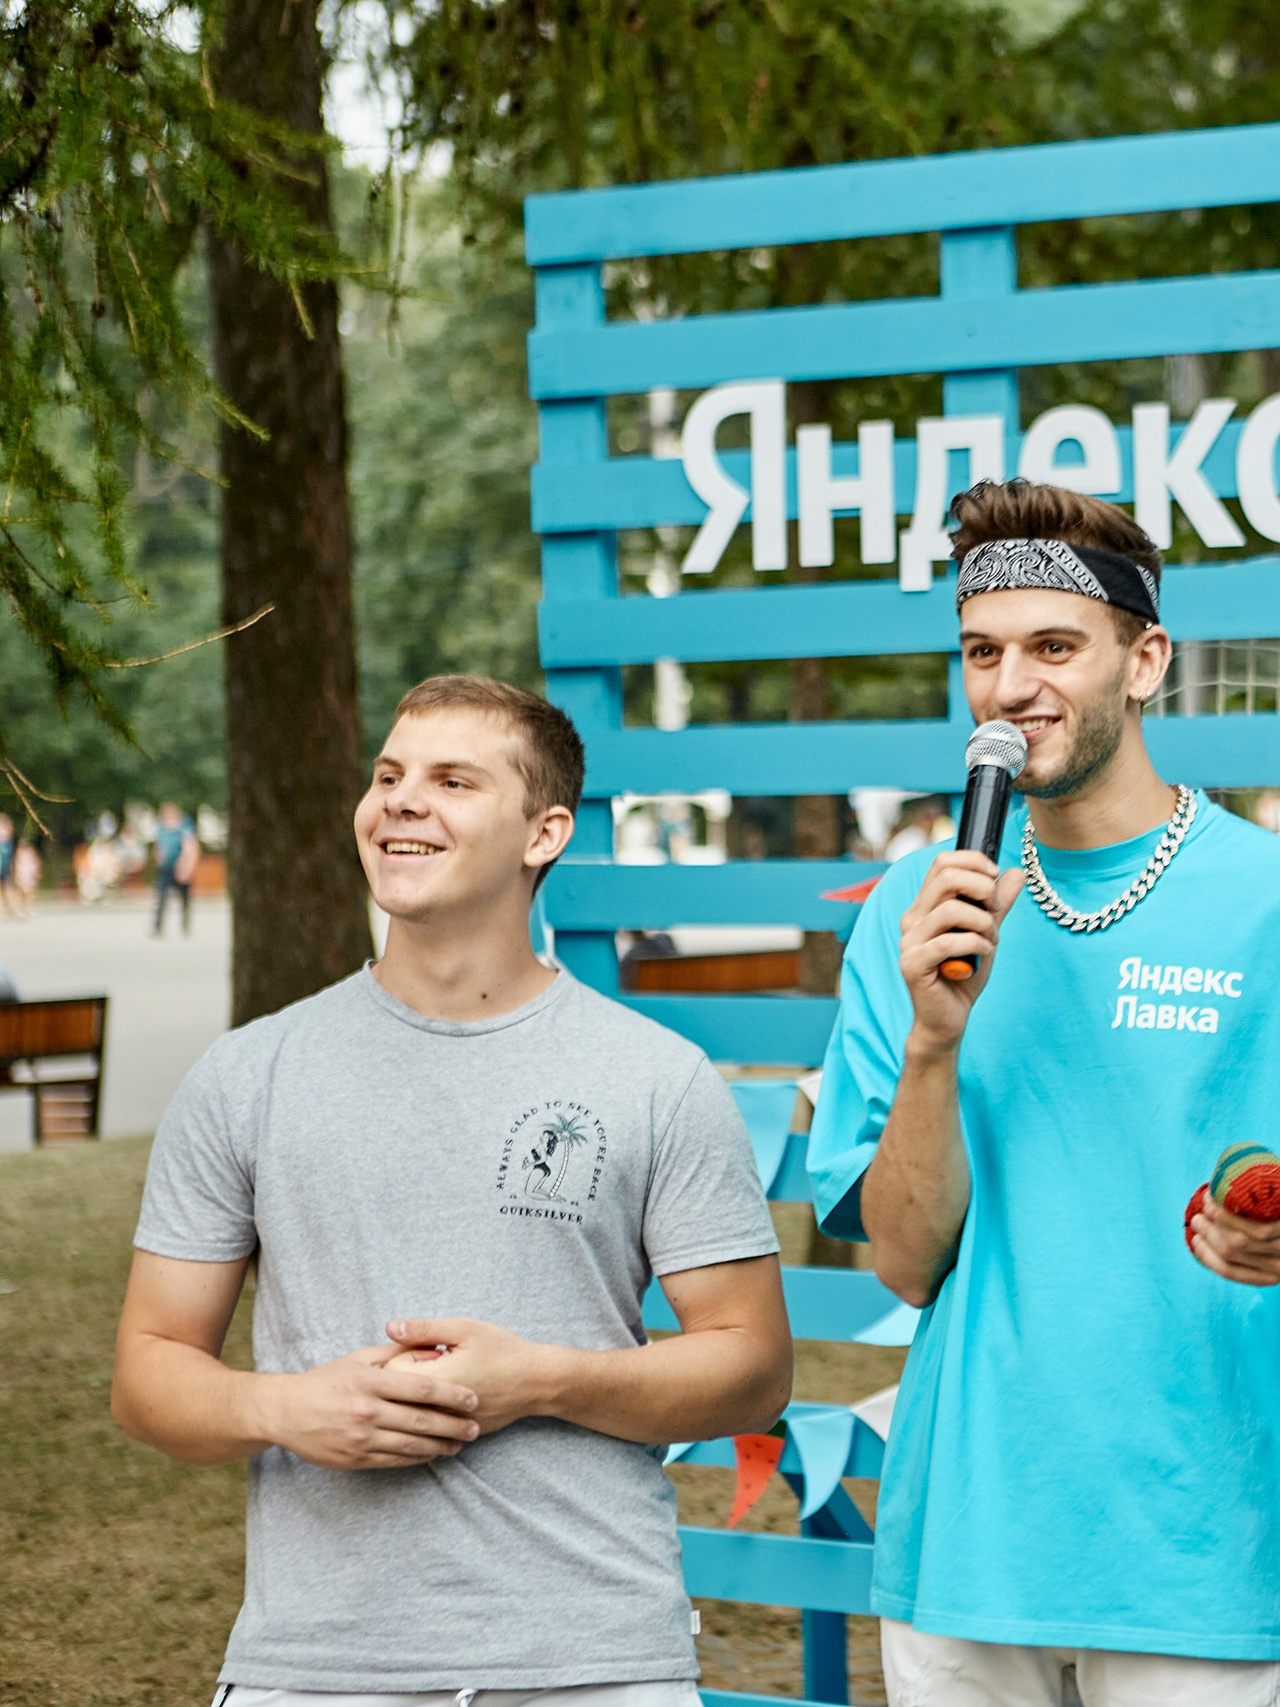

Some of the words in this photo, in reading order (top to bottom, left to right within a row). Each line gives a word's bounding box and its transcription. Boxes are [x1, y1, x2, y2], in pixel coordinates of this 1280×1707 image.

[1117, 956, 1244, 998] Яндекс
[1111, 995, 1219, 1034] Лавка
[496, 1138, 514, 1190] ALWAYS
[510, 1107, 539, 1134] GLAD
[544, 1100, 562, 1110] TO
[567, 1102, 592, 1118] SEE
[588, 1168, 602, 1202] BACK
[499, 1205, 584, 1226] QUIKSILVER
